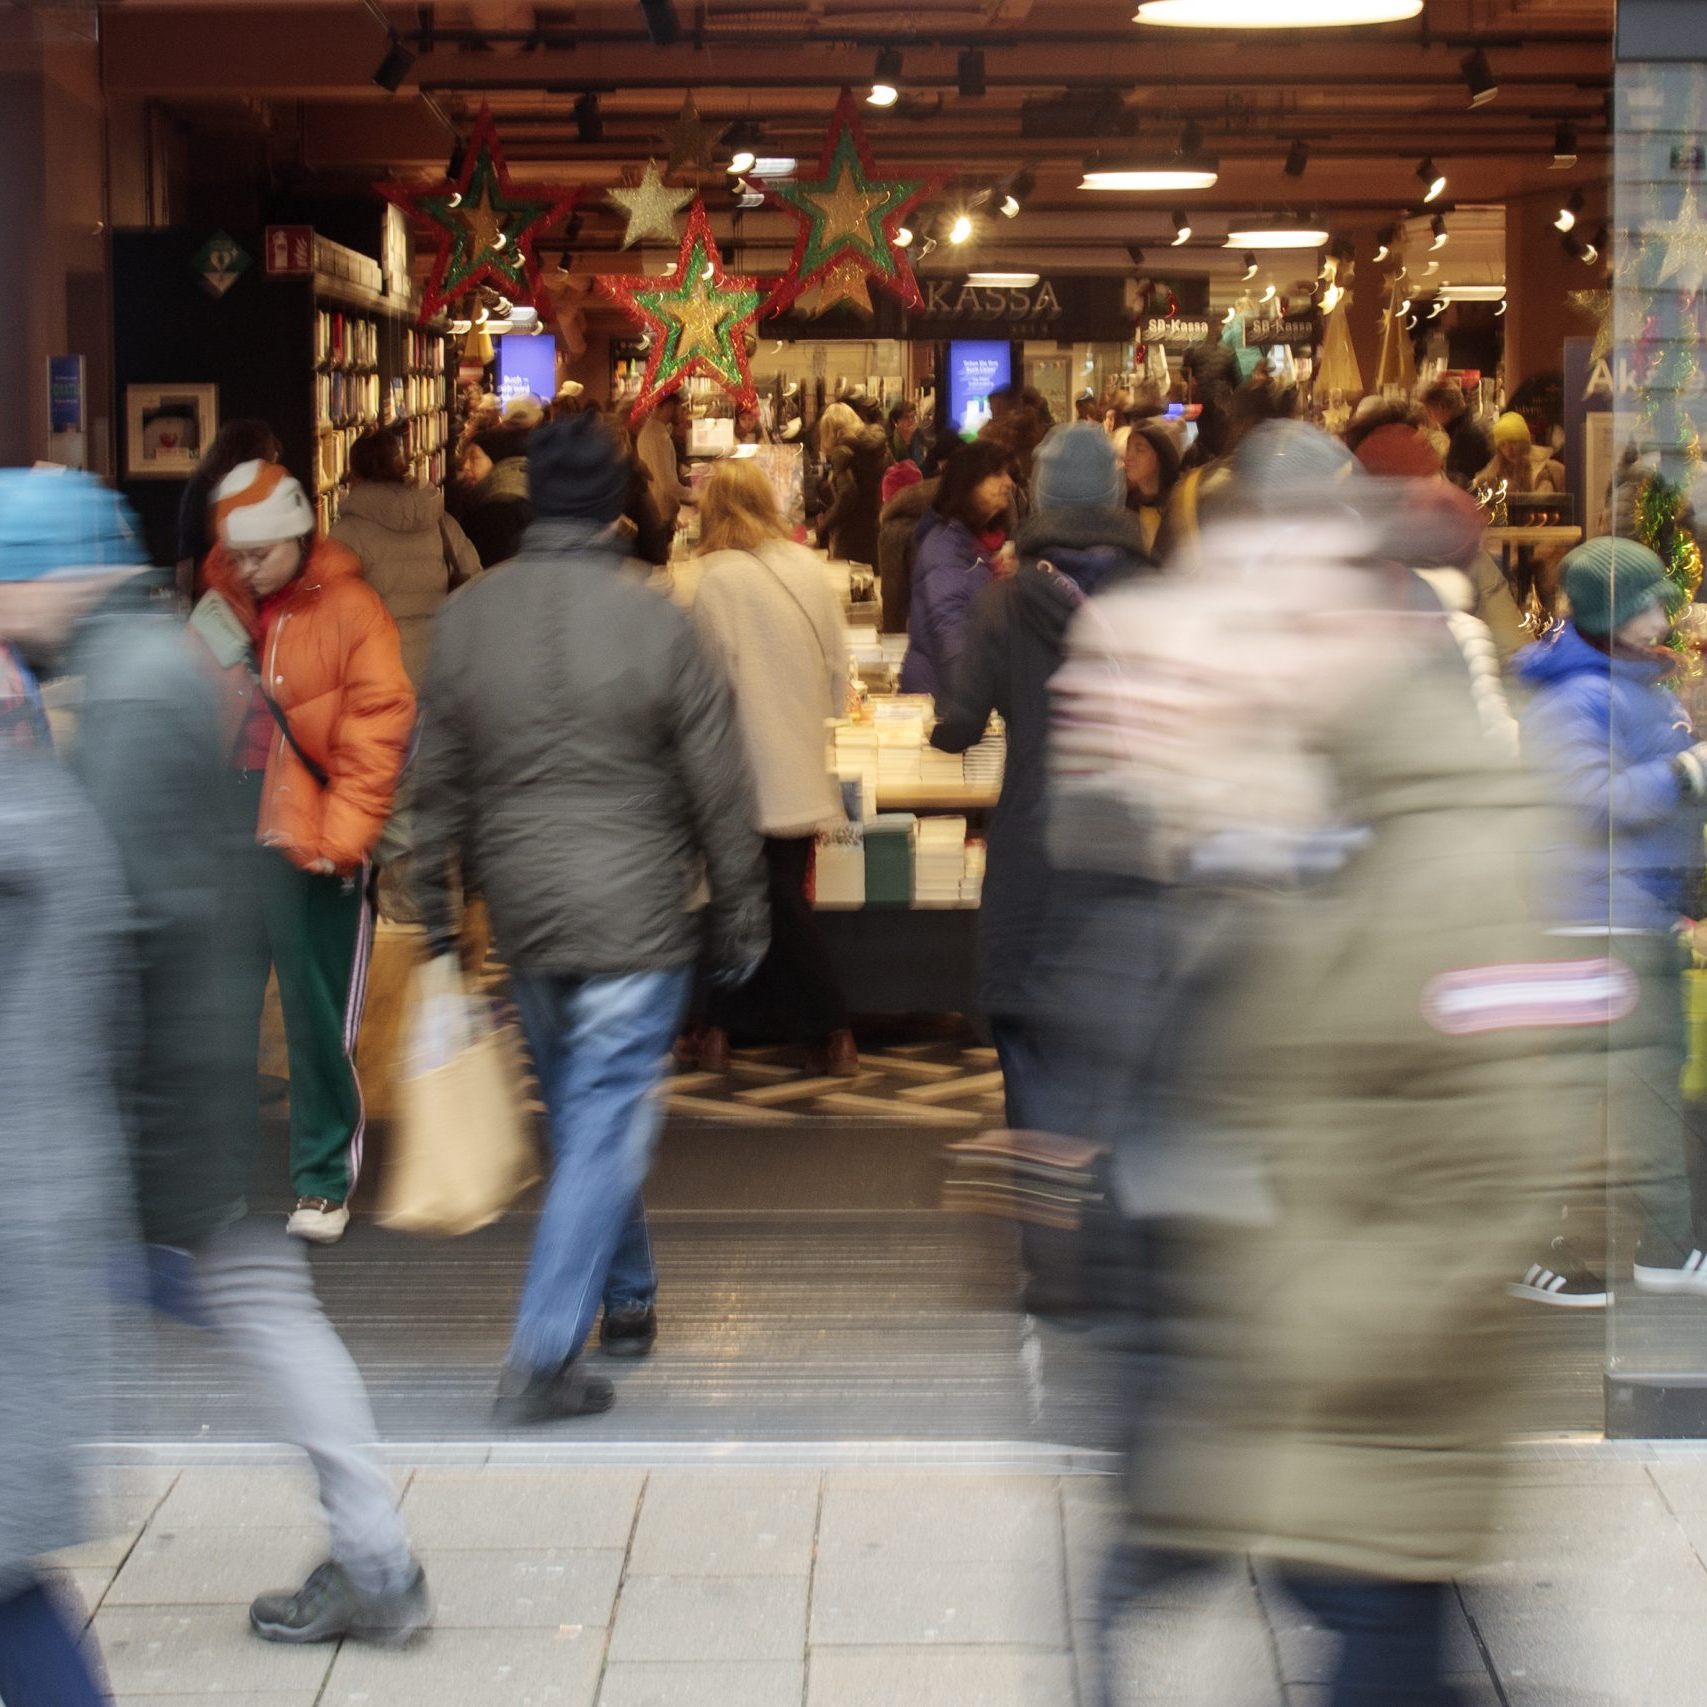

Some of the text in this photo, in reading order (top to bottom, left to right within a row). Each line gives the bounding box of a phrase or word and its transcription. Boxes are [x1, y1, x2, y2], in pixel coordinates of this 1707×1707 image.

[926, 279, 1062, 312] KASSA
[1148, 318, 1208, 334] SB-Kassa
[1252, 319, 1312, 335] SB-Kassa
